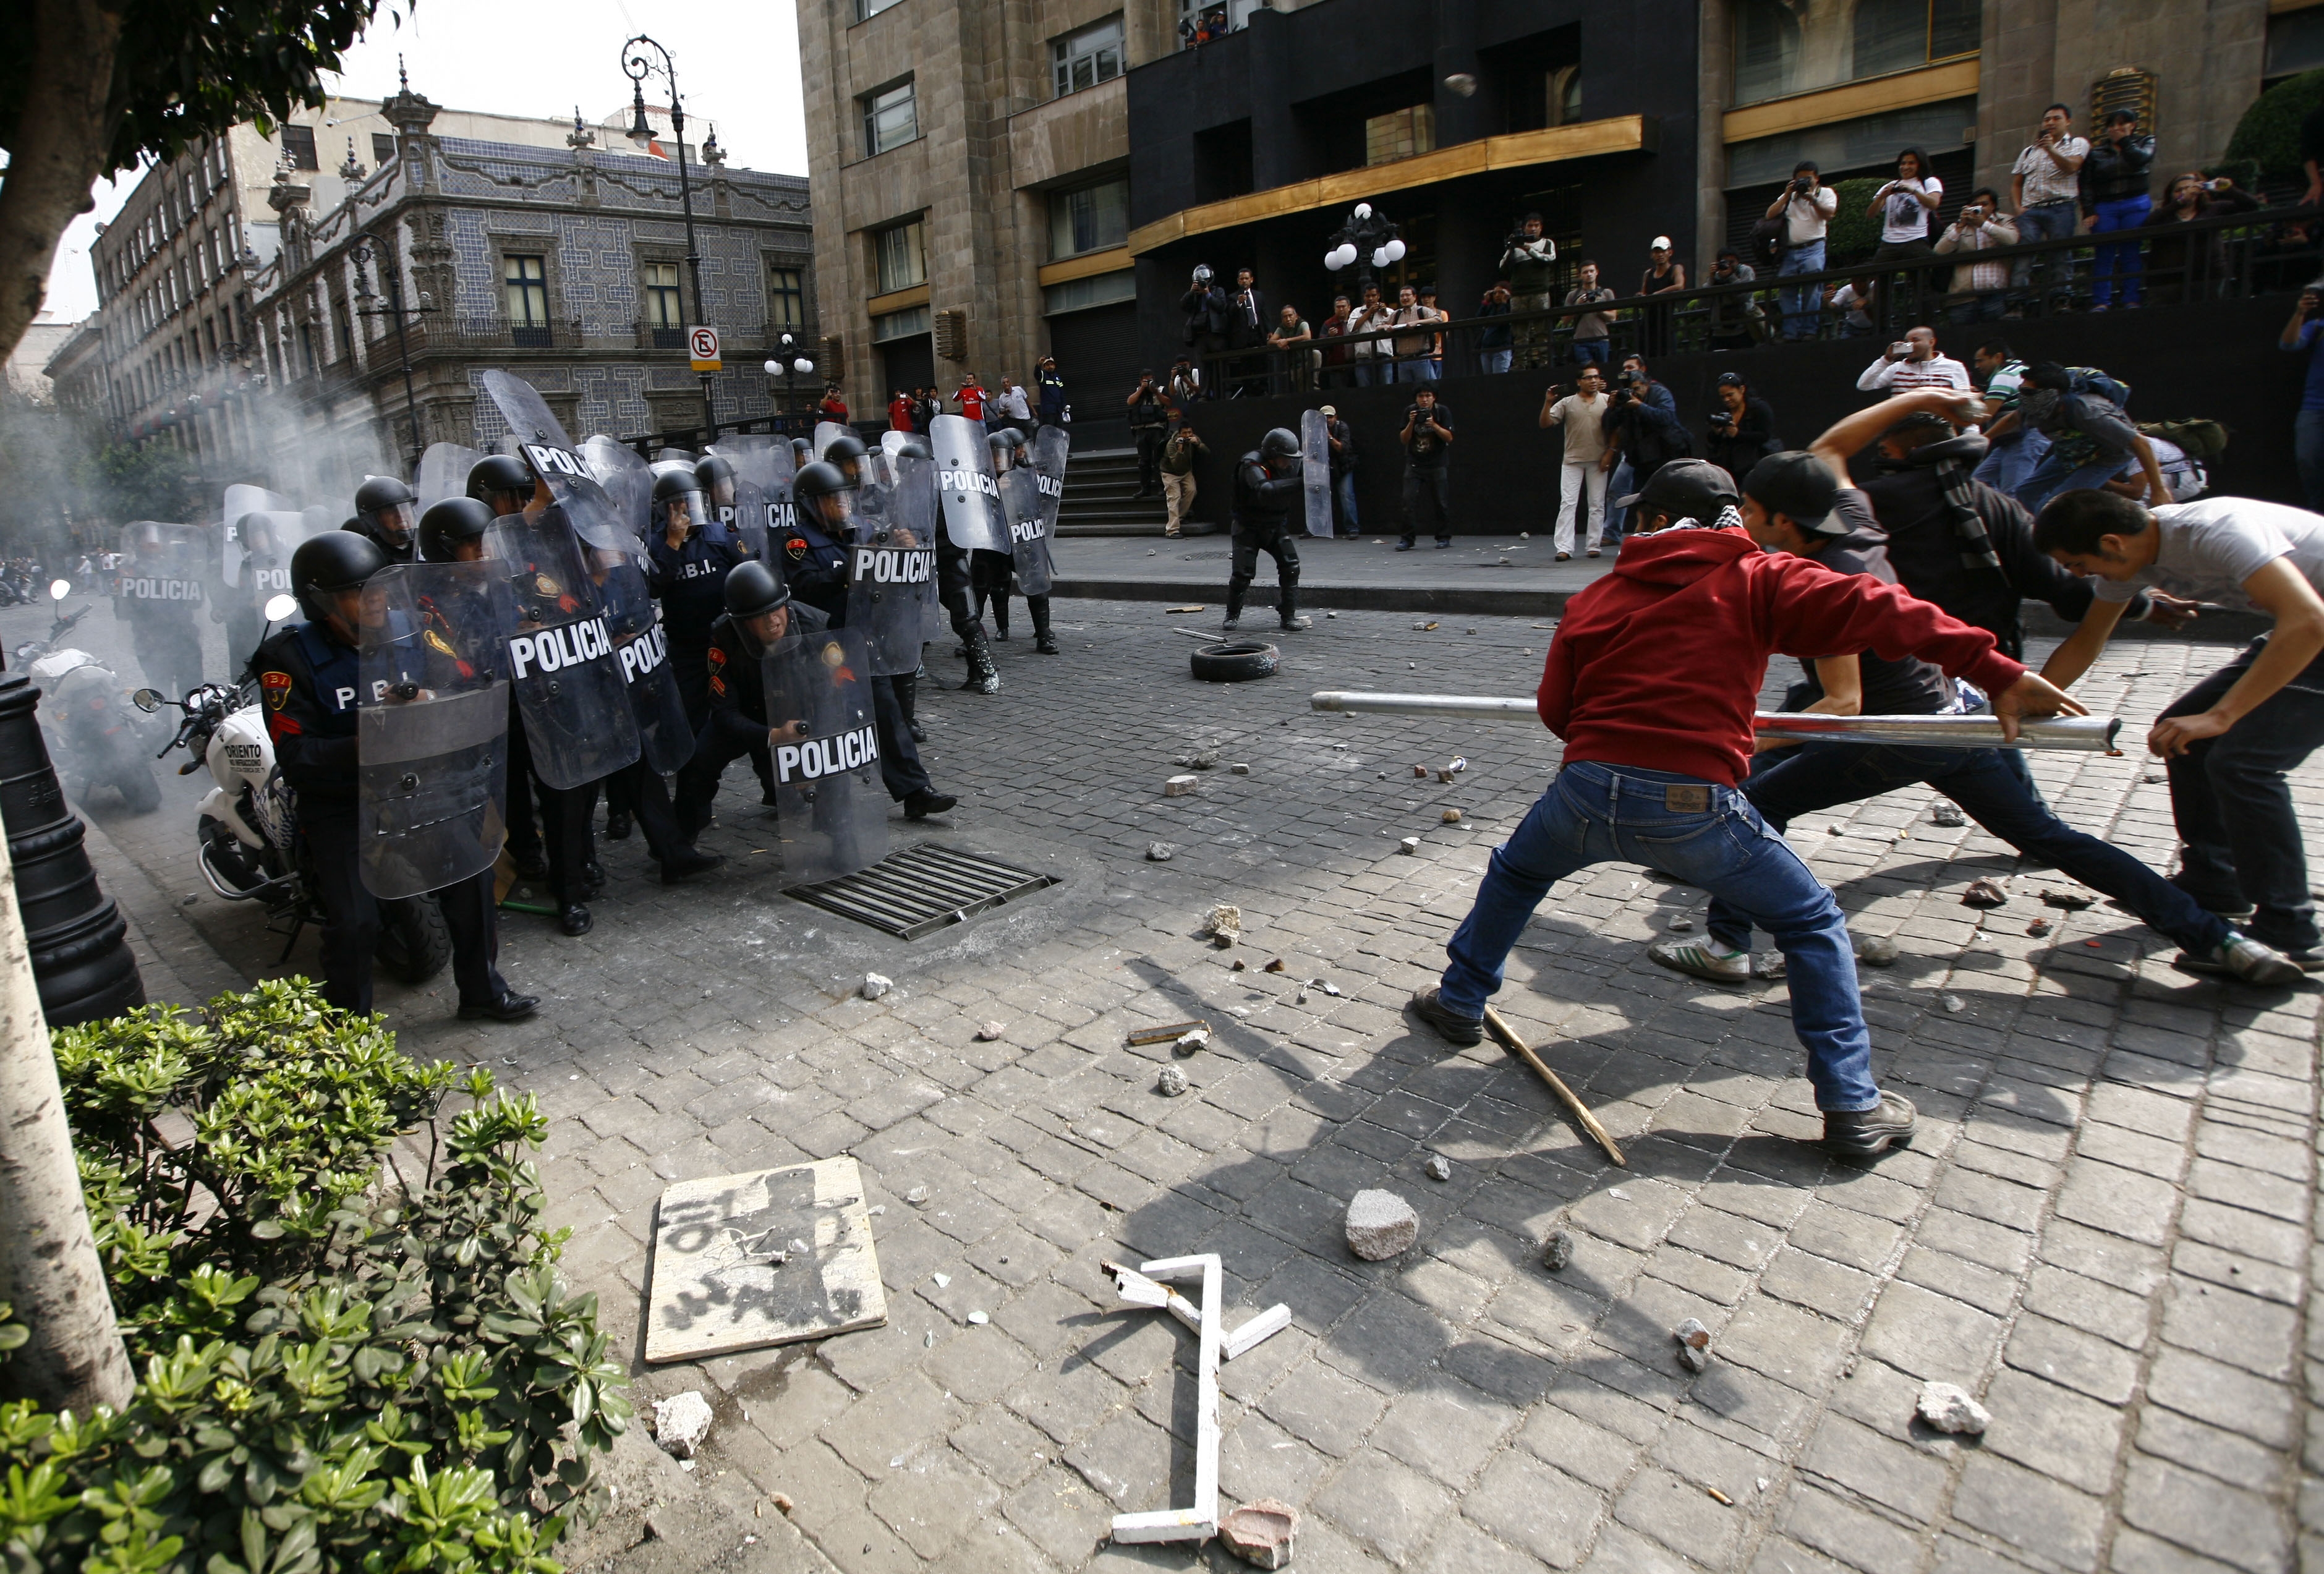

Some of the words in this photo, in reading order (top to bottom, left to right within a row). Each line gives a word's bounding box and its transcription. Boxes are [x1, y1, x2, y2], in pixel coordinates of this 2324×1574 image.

[940, 471, 1000, 500] POLICIA
[855, 549, 930, 583] POLICIA
[122, 578, 202, 600] POLICIA
[509, 618, 612, 679] POLICIA
[778, 726, 877, 783] POLICIA
